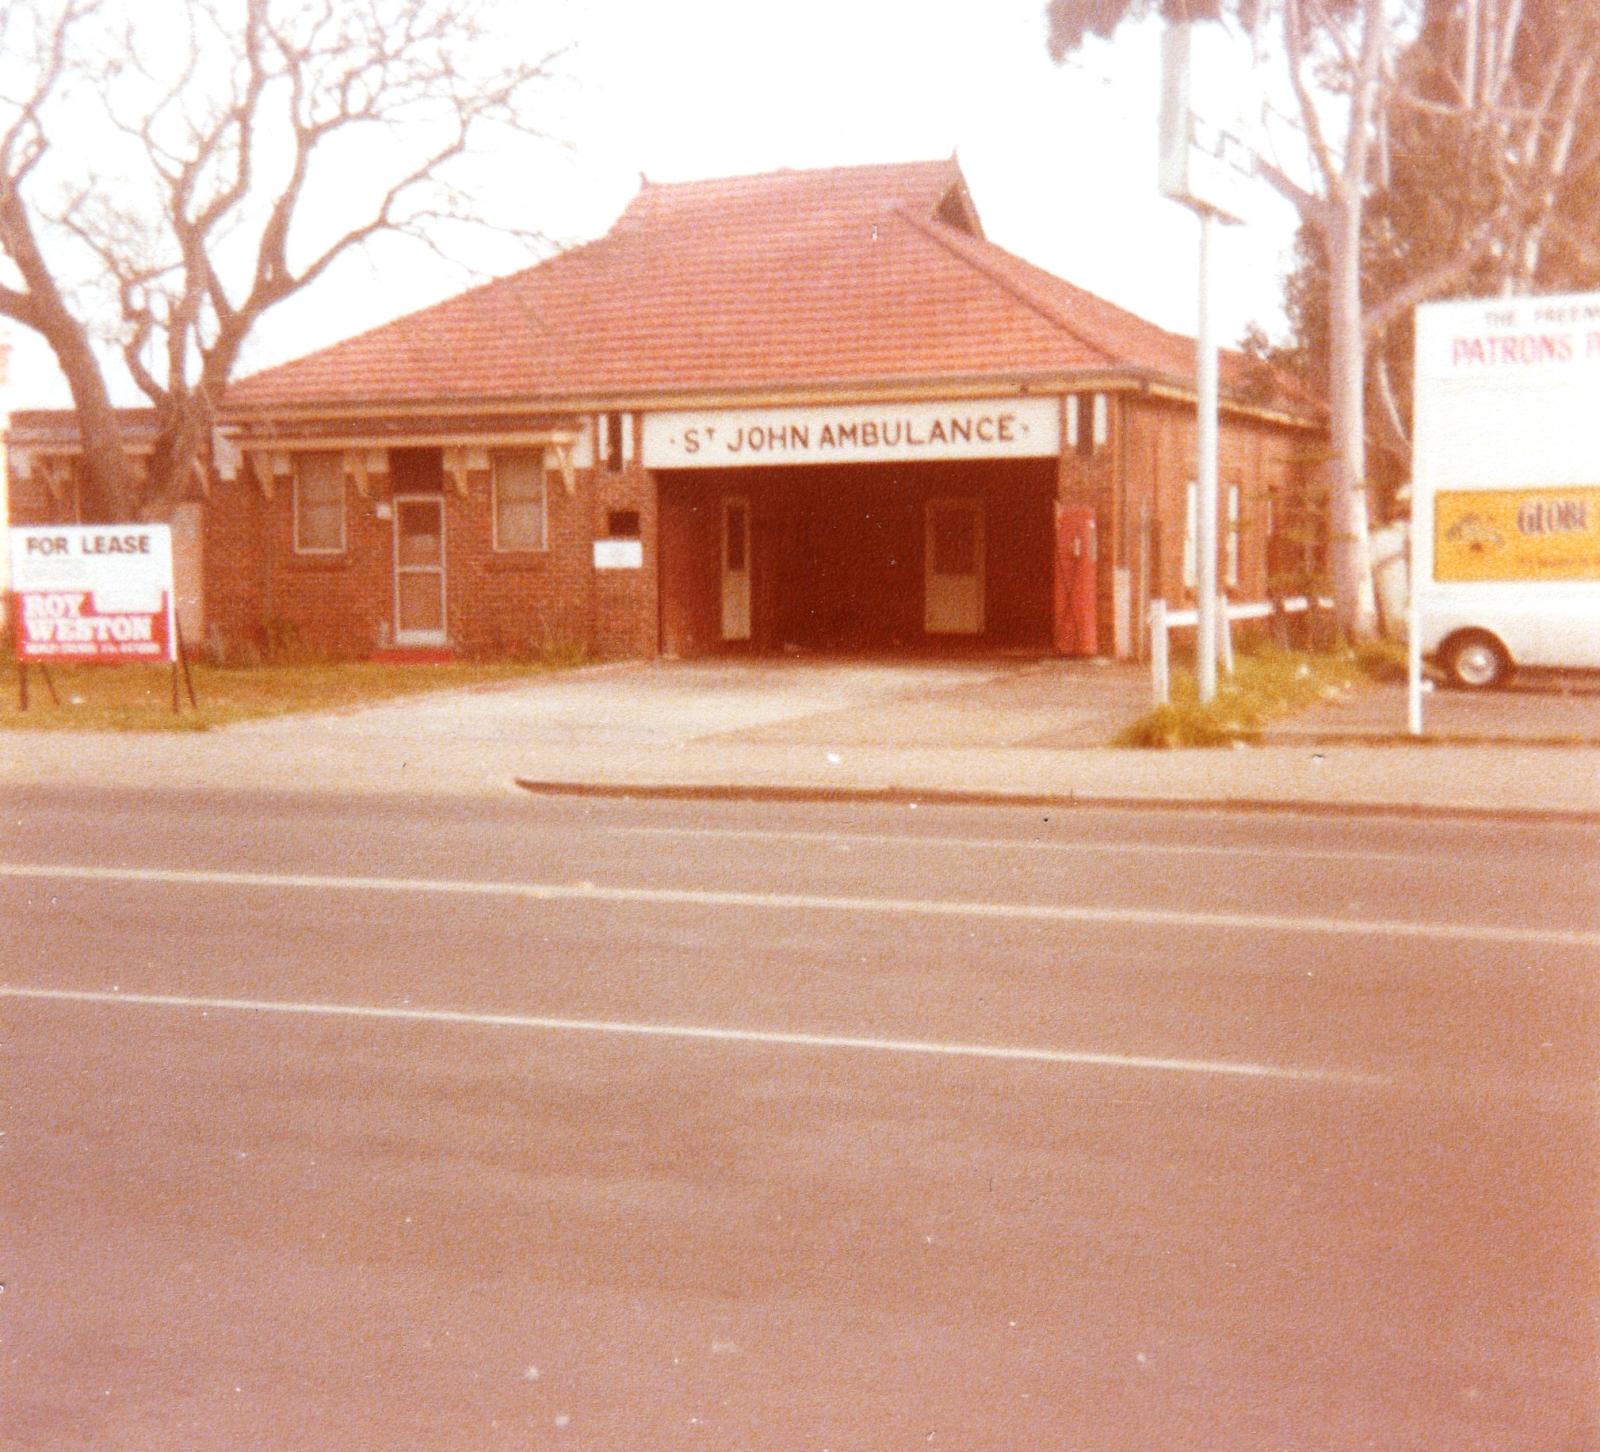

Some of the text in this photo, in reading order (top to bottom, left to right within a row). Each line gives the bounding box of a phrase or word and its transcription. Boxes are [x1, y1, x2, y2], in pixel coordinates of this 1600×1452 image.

[1453, 332, 1573, 366] PATRONS
[727, 425, 809, 452] JOHN
[819, 414, 1015, 447] AMBULANCE
[27, 535, 150, 555] FOR LEASE
[24, 595, 85, 617] ROY
[26, 616, 152, 642] WESTON
